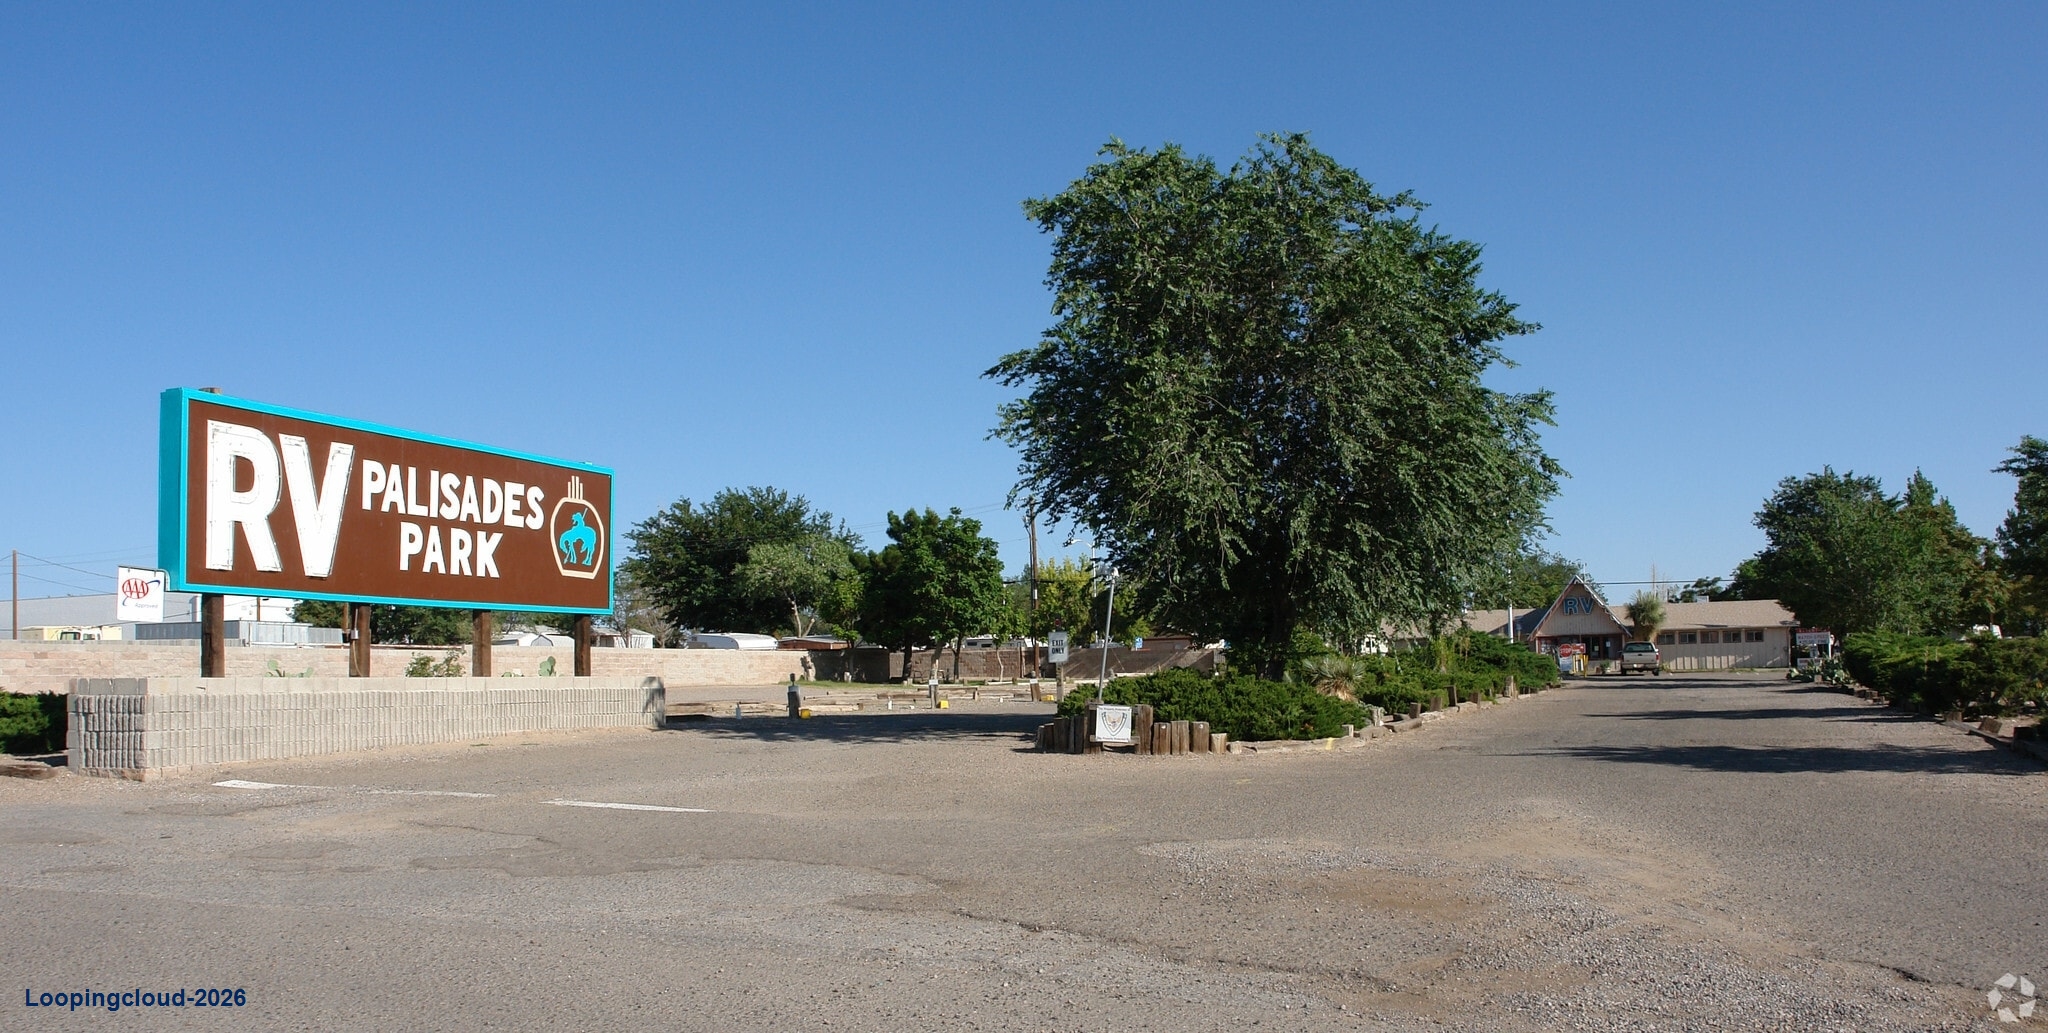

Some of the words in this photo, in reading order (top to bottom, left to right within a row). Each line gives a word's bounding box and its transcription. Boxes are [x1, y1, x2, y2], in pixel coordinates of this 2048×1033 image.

[206, 419, 356, 580] RV
[362, 459, 545, 531] PALISADES
[399, 521, 503, 578] PARK
[123, 578, 148, 599] AAA
[1564, 597, 1594, 615] RV
